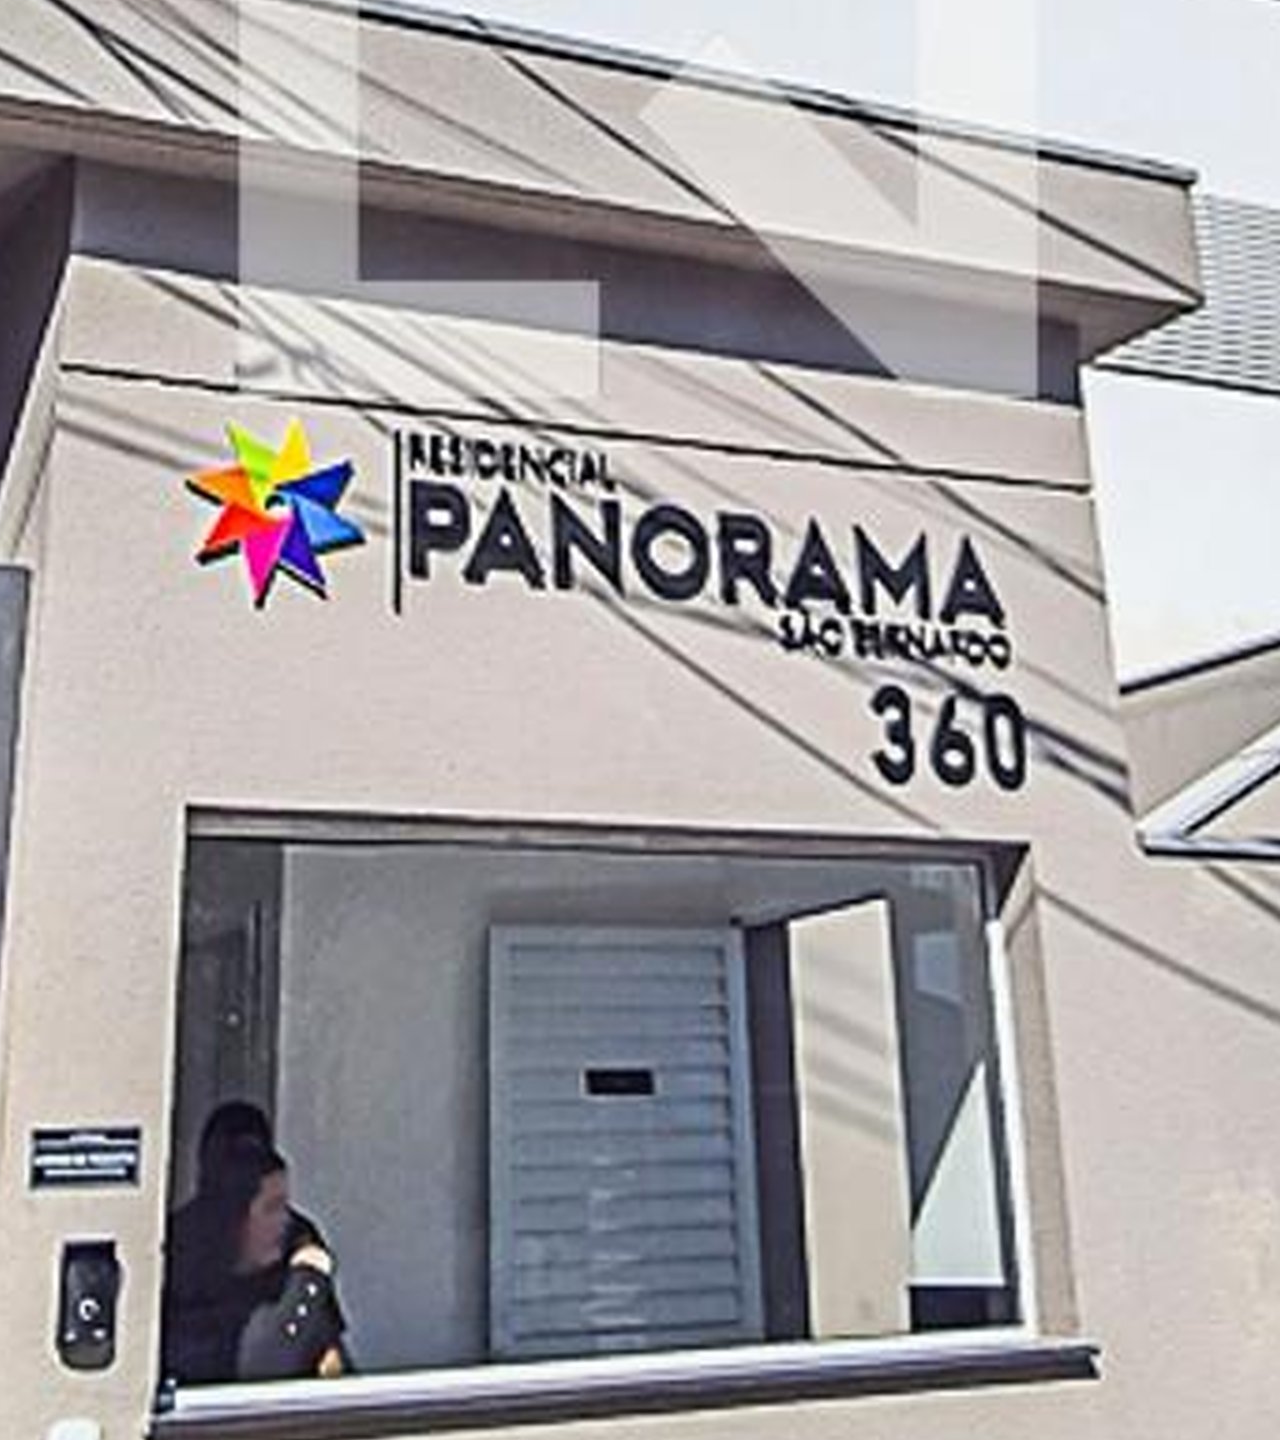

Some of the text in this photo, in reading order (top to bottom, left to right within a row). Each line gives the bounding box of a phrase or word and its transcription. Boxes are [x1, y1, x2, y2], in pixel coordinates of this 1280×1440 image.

[408, 432, 616, 493] RESIDENCIAL
[406, 479, 1006, 629] PANORAMA
[870, 685, 1026, 791] 360
